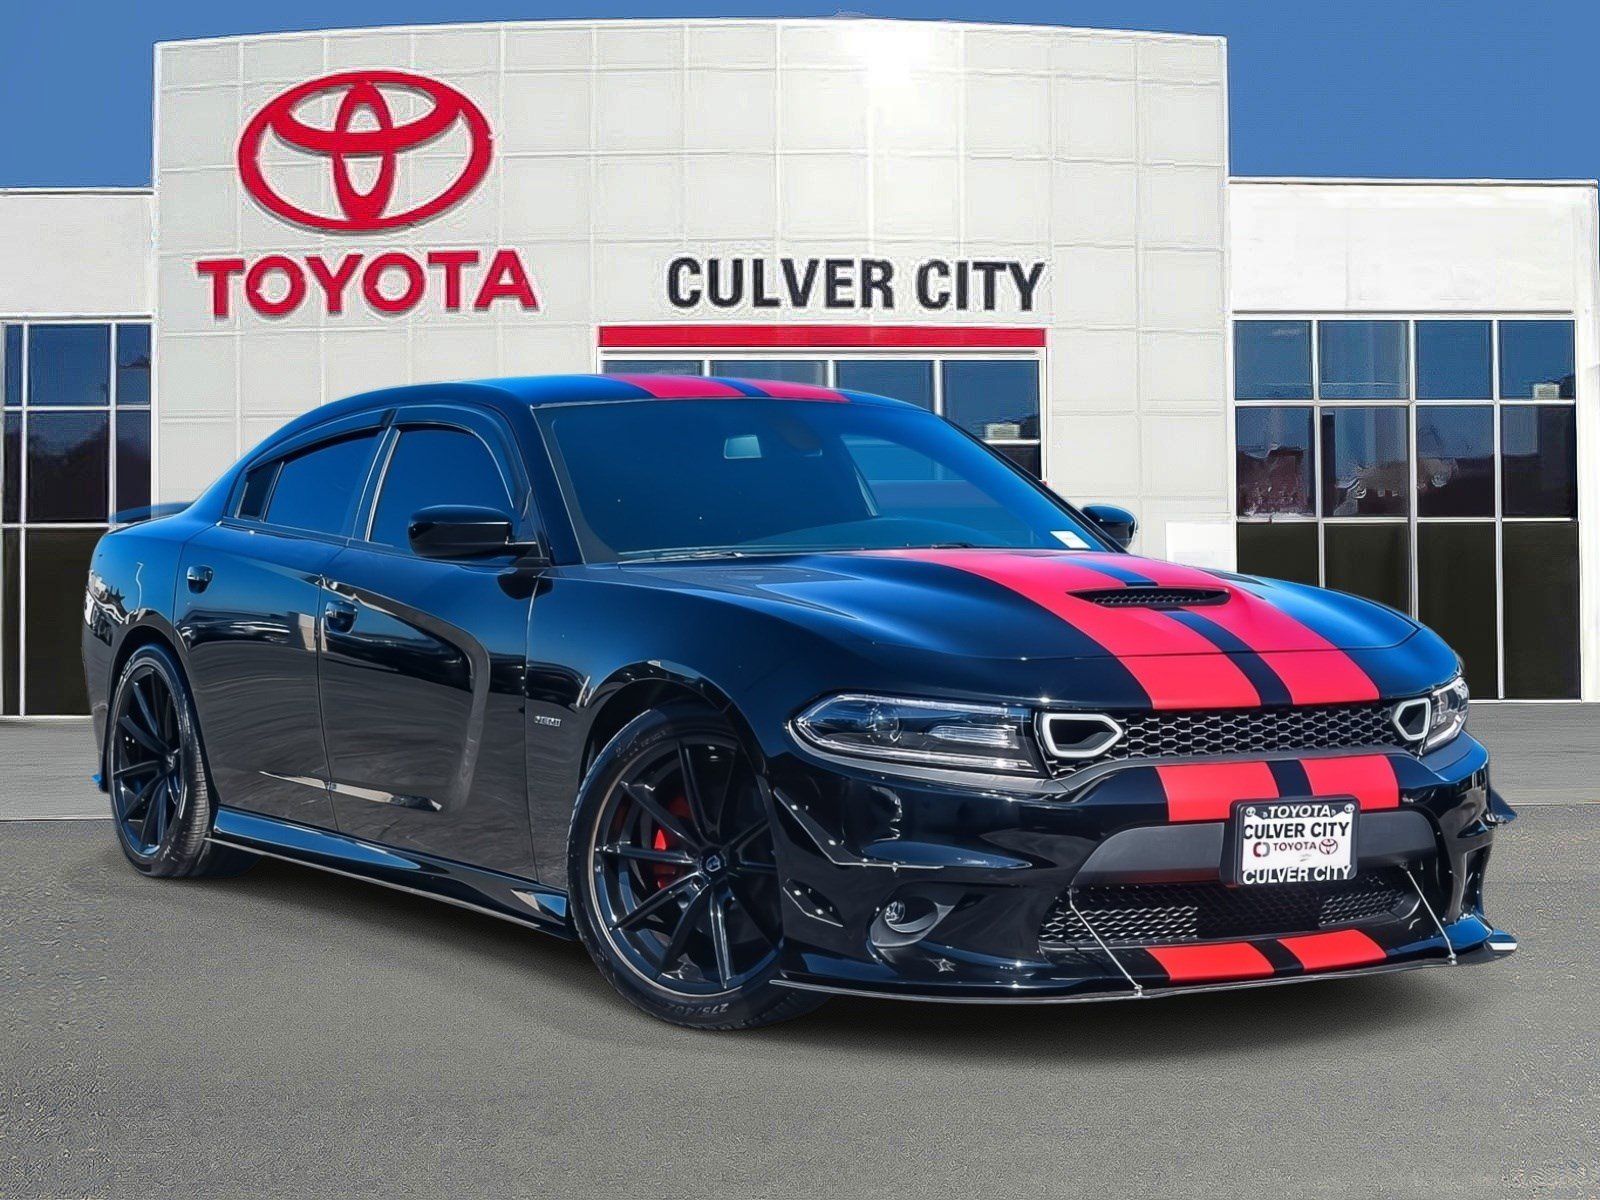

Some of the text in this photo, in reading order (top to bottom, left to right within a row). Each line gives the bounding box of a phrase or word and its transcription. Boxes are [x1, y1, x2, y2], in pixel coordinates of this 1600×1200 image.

[196, 249, 539, 318] TOYOTA
[667, 257, 1046, 312] CULVER CITY
[1268, 804, 1331, 819] TOYOTA
[1243, 821, 1350, 840] CULVER CITY
[1273, 841, 1317, 852] TOYOTA
[1242, 865, 1352, 885] CULVER CITY
